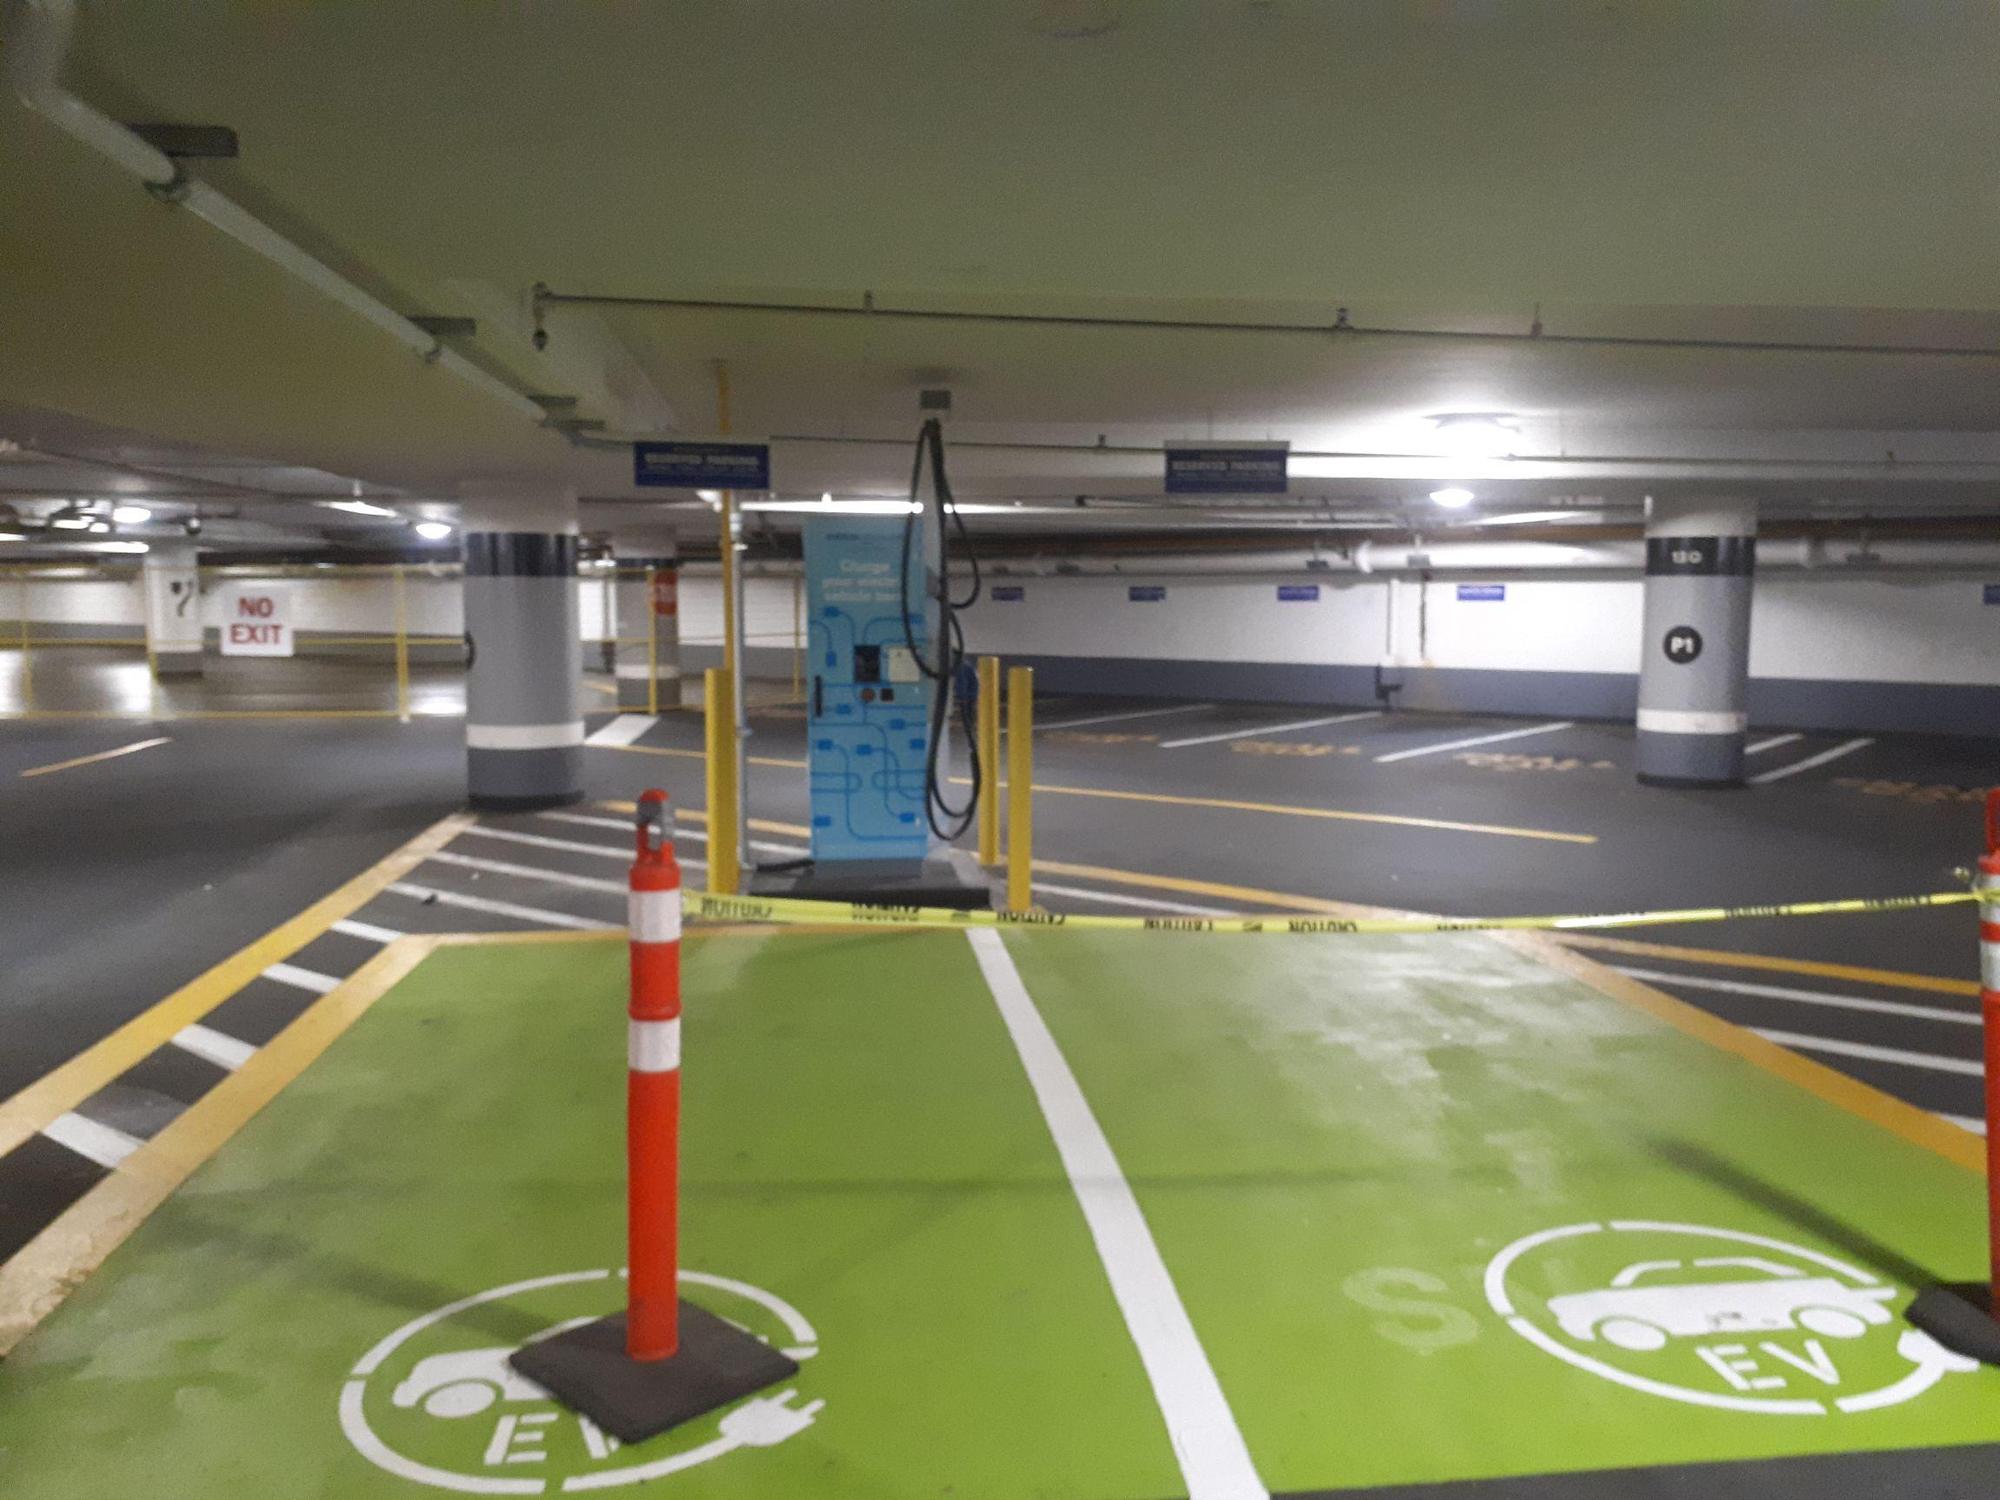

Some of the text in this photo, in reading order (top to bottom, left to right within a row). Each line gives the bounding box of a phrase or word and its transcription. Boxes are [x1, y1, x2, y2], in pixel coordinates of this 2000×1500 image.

[238, 597, 274, 618] NO
[230, 623, 282, 644] EXIT
[1670, 635, 1694, 654] P1
[1695, 1339, 1840, 1391] EV
